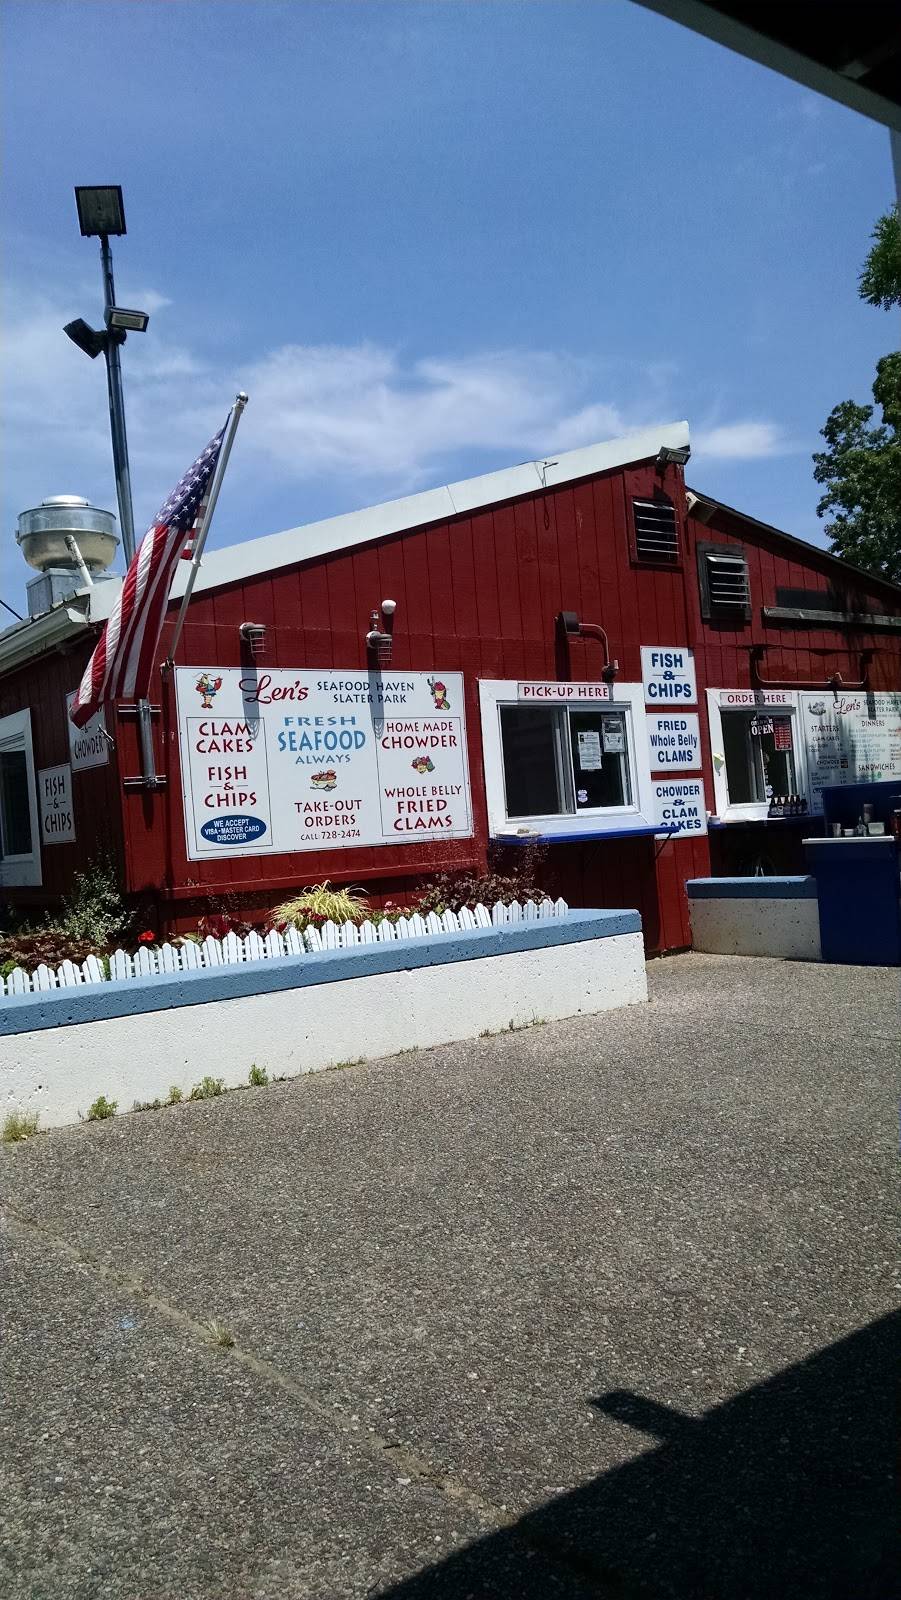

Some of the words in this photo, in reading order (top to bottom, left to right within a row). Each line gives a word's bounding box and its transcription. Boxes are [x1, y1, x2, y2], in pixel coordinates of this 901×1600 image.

[651, 653, 683, 668] FISH
[663, 670, 675, 680] &
[239, 675, 309, 704] Len's
[317, 681, 370, 691] SEAFOOD
[376, 681, 414, 691] HAVEN
[523, 686, 574, 697] PICK-UP
[578, 687, 608, 697] HERE
[648, 683, 692, 698] CHIPS
[333, 694, 373, 703] SLATER
[378, 694, 406, 703] PARK
[727, 694, 760, 703] ORDER
[763, 694, 787, 703] HERE
[284, 716, 356, 726] FRESH
[386, 722, 419, 732] HOME
[423, 721, 453, 732] MADE
[657, 720, 687, 731] FRIED
[199, 722, 252, 736] CLAM
[751, 724, 774, 735] OPEN
[196, 738, 253, 753] CAKES
[278, 730, 365, 751] SEAFOOD
[381, 735, 458, 749] CHOWDER
[650, 734, 676, 747] Whole
[678, 734, 697, 748] Belly
[74, 735, 104, 760] CHOWDER
[295, 754, 351, 764] ALWAYS
[657, 750, 693, 762] CLAMS
[208, 766, 247, 780] FISH
[858, 763, 896, 771] SANDWICHES
[45, 775, 65, 798] FISH
[223, 782, 234, 790] &
[384, 786, 427, 797] WHOLE
[431, 785, 462, 796] BELLY
[656, 785, 700, 797] CHOWDER
[204, 792, 257, 808] CHIPS
[295, 800, 362, 813] TAKE-OUT
[397, 800, 448, 814] FRIED
[662, 807, 698, 819] CLAM
[44, 812, 72, 834] CHIPS
[225, 819, 249, 827] ACCEPT
[304, 815, 356, 827] ORDERS
[393, 815, 453, 831] CLAMS
[217, 833, 247, 841] DISCOVER
[321, 830, 360, 839] 728-2474
